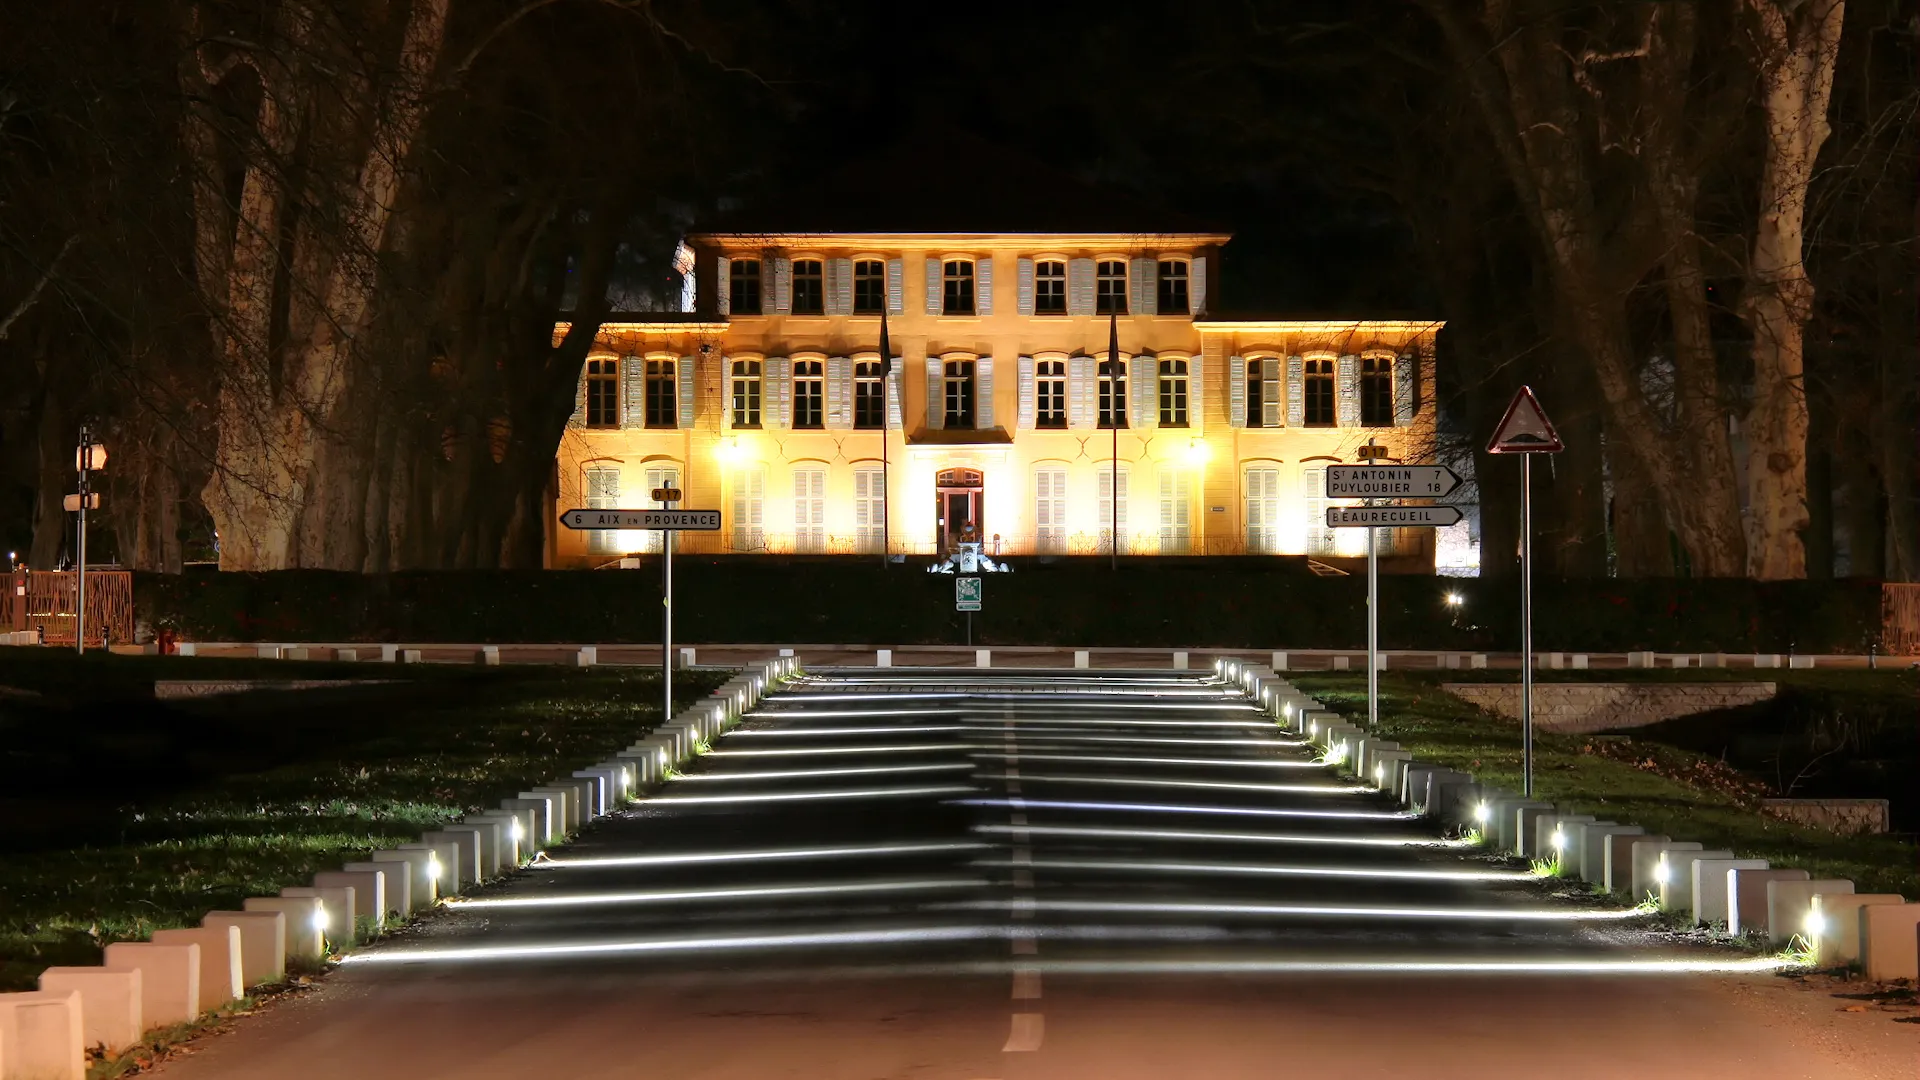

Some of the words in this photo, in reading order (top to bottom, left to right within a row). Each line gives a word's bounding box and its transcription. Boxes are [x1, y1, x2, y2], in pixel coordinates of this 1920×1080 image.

[1360, 447, 1368, 457] D
[1372, 447, 1385, 457] 17
[1352, 470, 1412, 480] ANTONIN
[1434, 470, 1441, 480] 7
[1333, 483, 1410, 493] PUYLOUBIER
[1427, 483, 1441, 493] 18
[654, 490, 661, 500] D
[666, 490, 679, 500] 17
[575, 514, 582, 524] 6
[598, 514, 620, 524] AIX
[645, 515, 716, 525] PROVENCE
[1333, 511, 1432, 521] BEAURECUEIL
